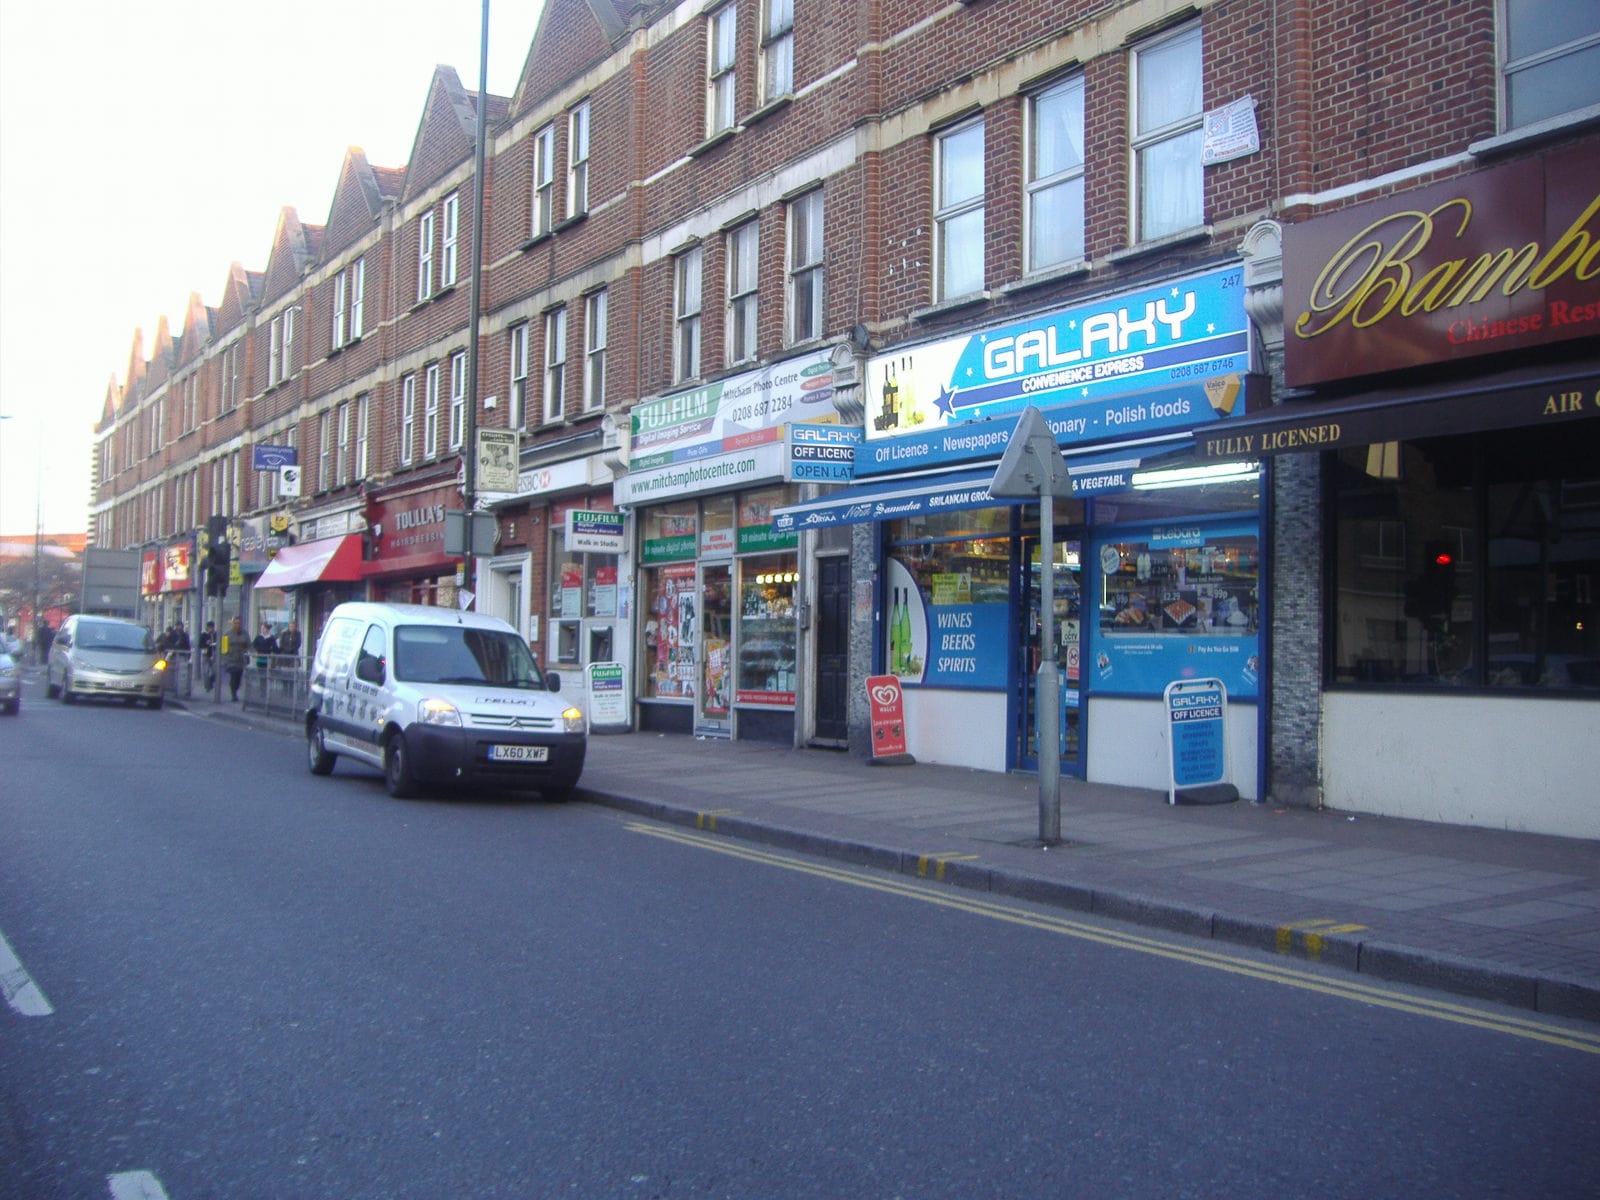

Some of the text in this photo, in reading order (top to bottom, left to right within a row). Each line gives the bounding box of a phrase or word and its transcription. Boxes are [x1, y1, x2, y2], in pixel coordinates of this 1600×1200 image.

[1221, 274, 1241, 289] 247
[983, 291, 1196, 380] GALAXY
[1448, 313, 1542, 345] Chinese
[1022, 355, 1145, 393] CONVENIENCE EXPRESS
[1170, 357, 1234, 380] 0208 687 6746
[723, 384, 752, 400] Mitcham
[753, 379, 773, 393] Photo
[774, 373, 799, 387] Centre
[640, 390, 708, 431] FUJIFILM
[732, 404, 752, 422] 0208
[754, 400, 769, 416] 687
[771, 394, 793, 413] 2284
[1543, 391, 1583, 416] AIR
[679, 423, 702, 435] Service
[793, 429, 861, 442] GALAXY
[875, 448, 890, 463] Off
[891, 443, 929, 460] Licence
[943, 430, 1009, 453] Newspapers
[1105, 405, 1147, 424] Polish
[1150, 397, 1191, 419] foods
[1207, 423, 1340, 456] FULLY LICENSED
[794, 447, 855, 459] OFF LICENC
[630, 458, 756, 494] www.mitchamphotocentre.com
[795, 465, 855, 478] OPEN LAT
[1080, 474, 1126, 490] VEGETABL
[928, 492, 969, 507] SRILANKAN
[577, 513, 619, 523] FUJIFILM
[1161, 527, 1200, 540] Lebara
[937, 612, 973, 629] WINES
[941, 634, 976, 651] BEERS
[1064, 633, 1078, 641] CCTV
[937, 657, 976, 673] SPIRITS
[1172, 694, 1219, 707] GALAXY
[1173, 707, 1220, 719] OFF LICENCE
[495, 746, 546, 759] LX60 XWF
